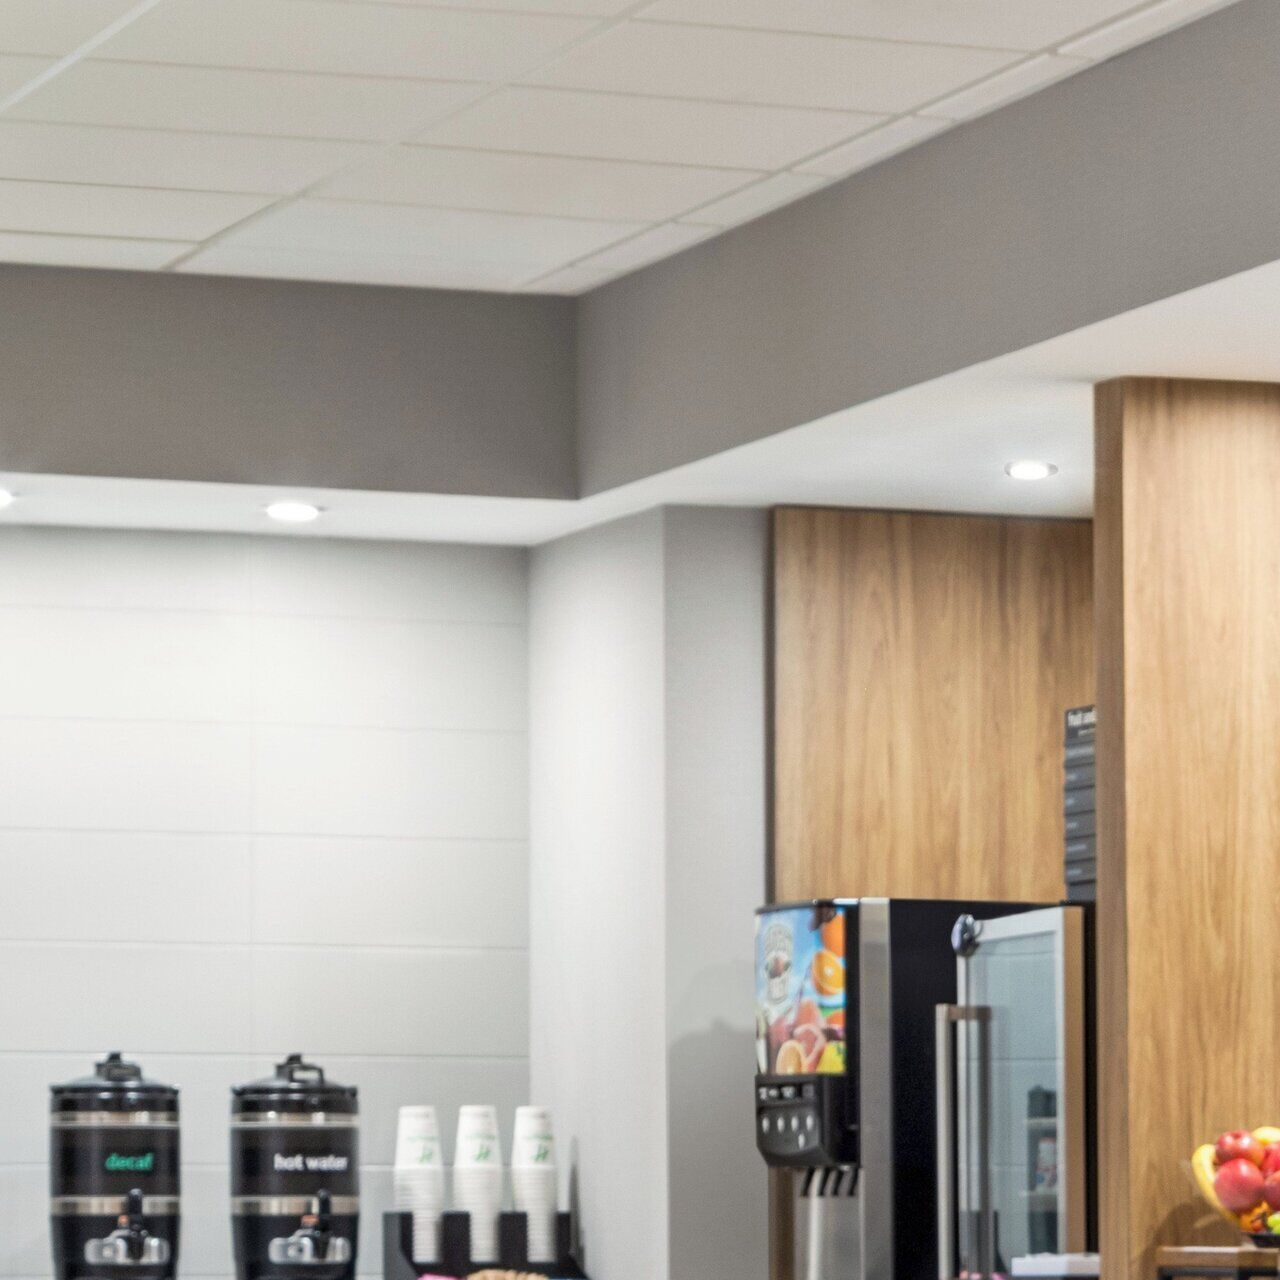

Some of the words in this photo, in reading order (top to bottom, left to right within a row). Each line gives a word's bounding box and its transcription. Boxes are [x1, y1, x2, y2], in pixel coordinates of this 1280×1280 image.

[105, 1152, 154, 1171] decaf
[274, 1153, 304, 1171] hot
[305, 1155, 348, 1171] water
